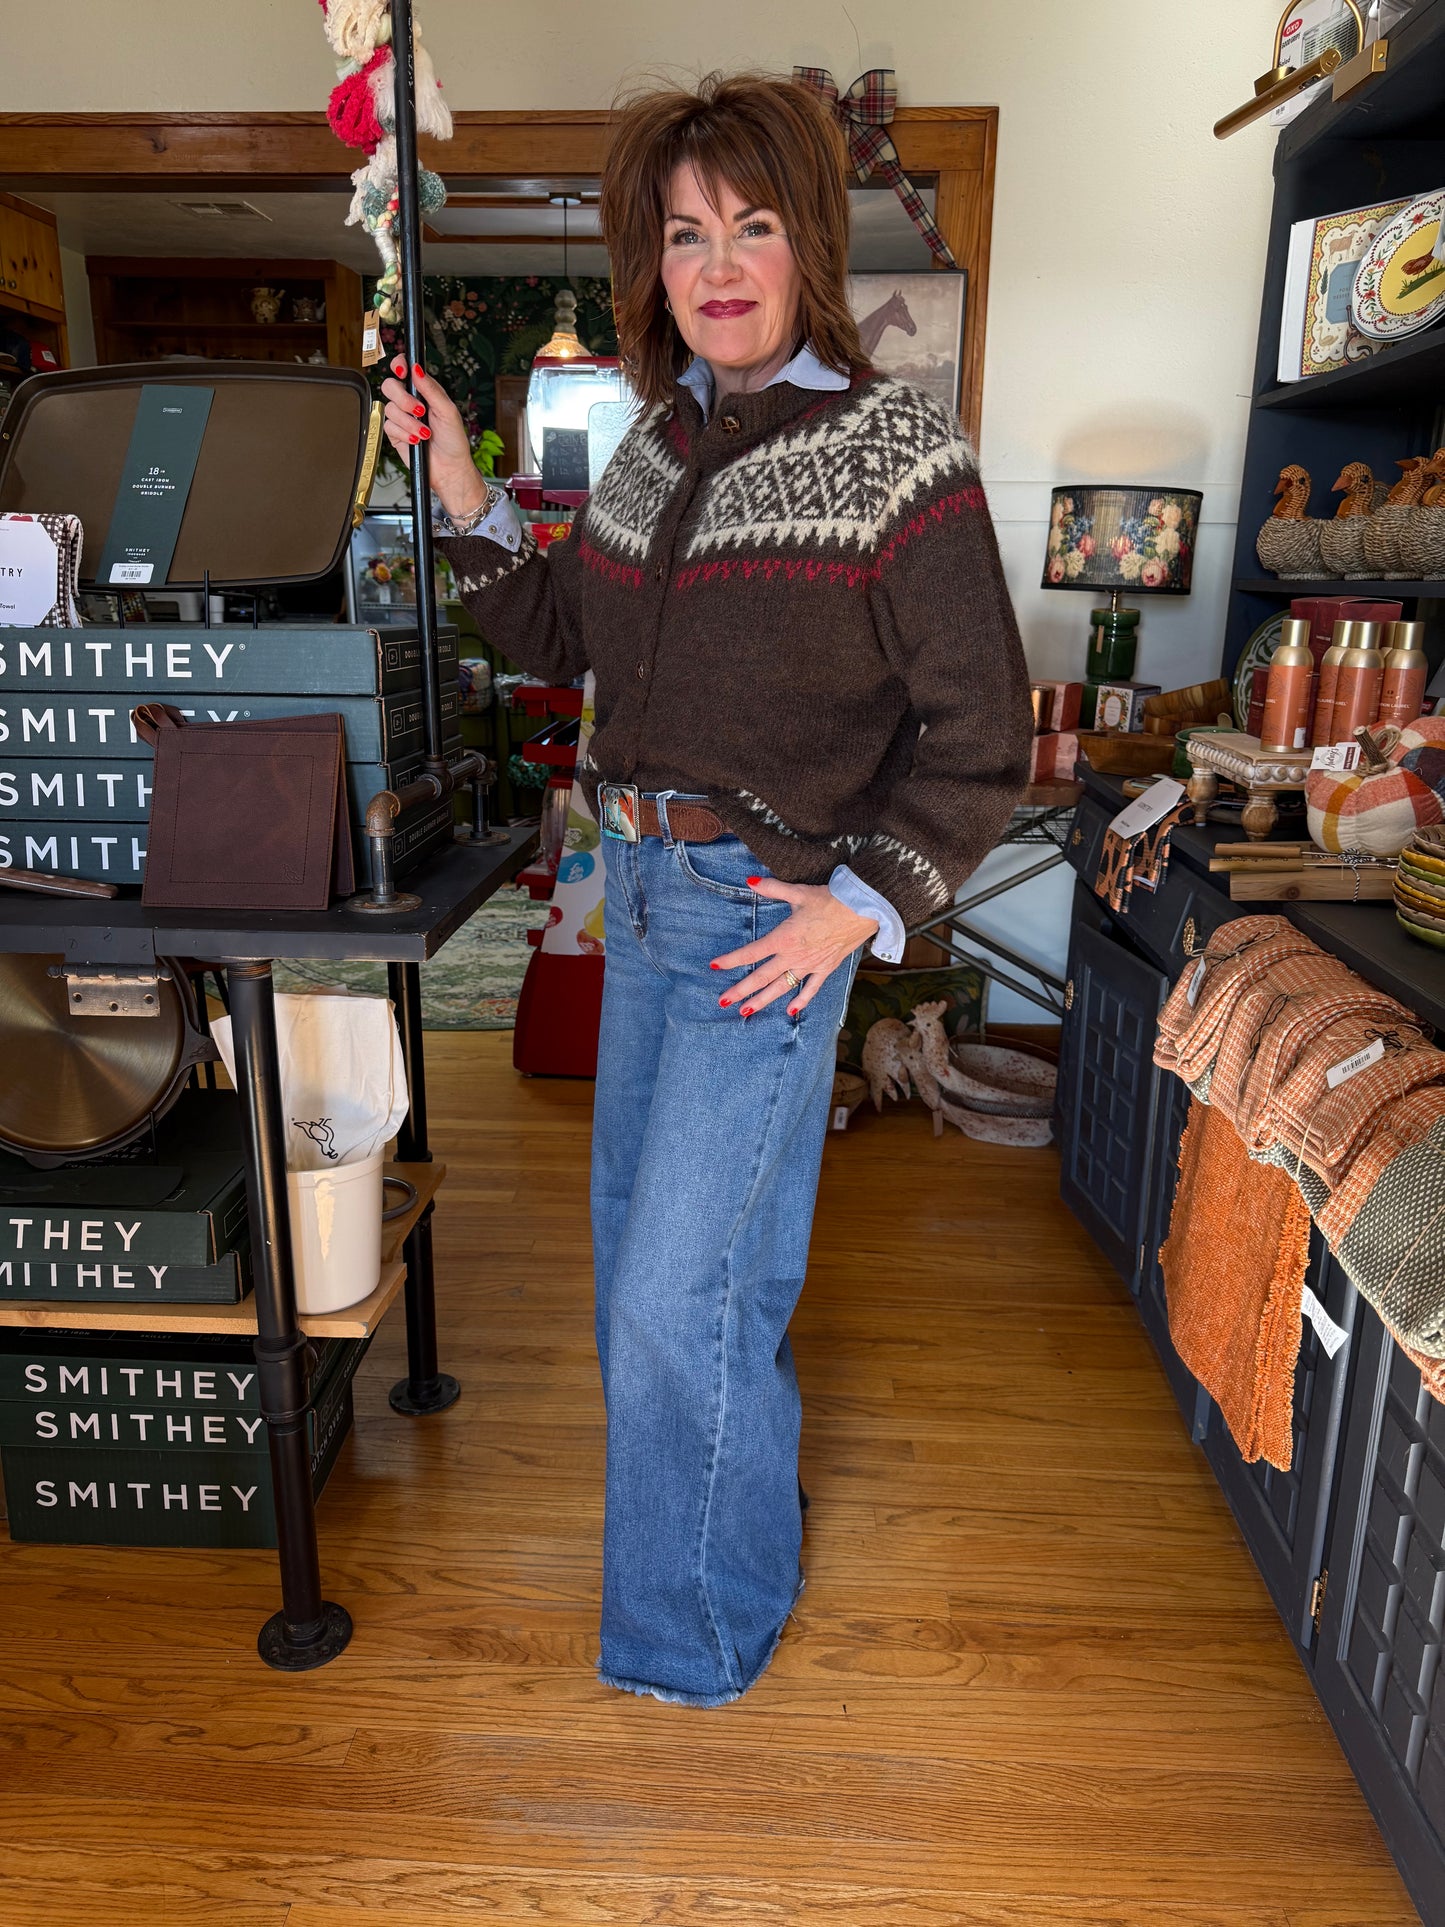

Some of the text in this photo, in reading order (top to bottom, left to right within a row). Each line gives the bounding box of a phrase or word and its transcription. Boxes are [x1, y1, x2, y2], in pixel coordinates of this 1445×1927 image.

[1286, 21, 1300, 35] OXO
[148, 466, 160, 475] 18
[9, 1218, 142, 1252] THEY
[24, 1364, 255, 1401] SMITHEY
[35, 1411, 263, 1444] SMITHEY
[310, 1401, 344, 1475] UTCH OVEN
[35, 1480, 258, 1512] SMITHEY
